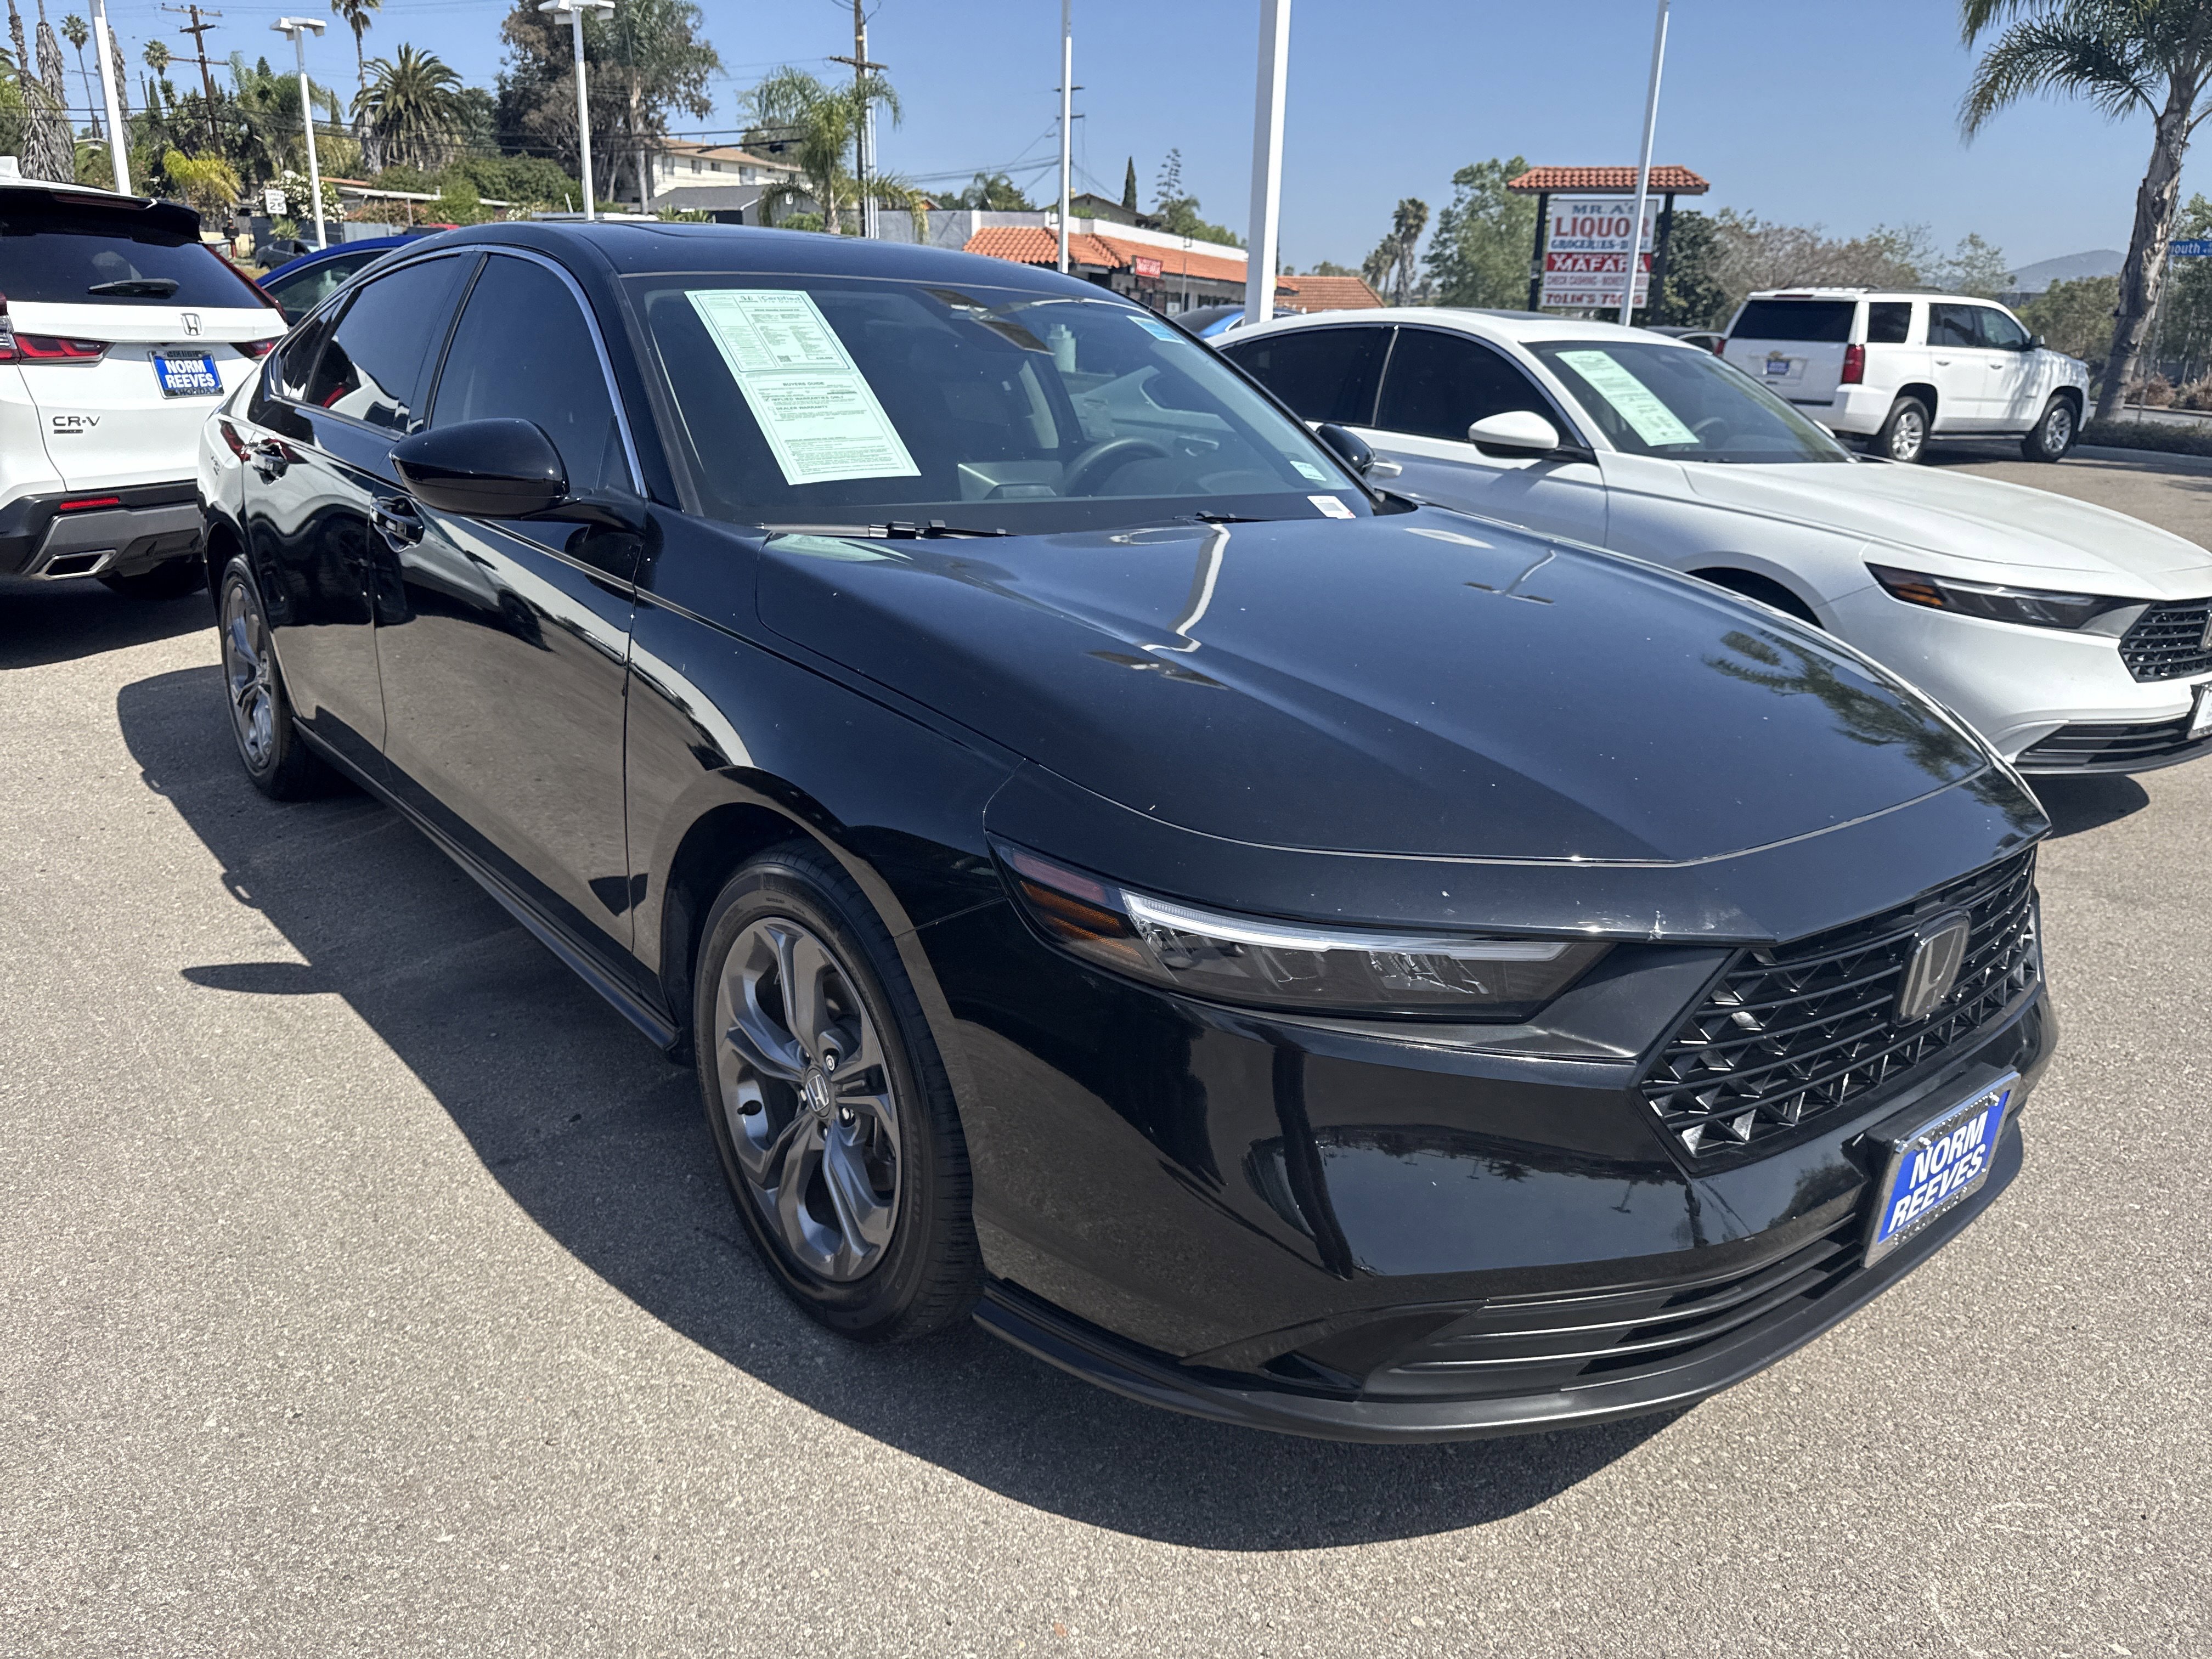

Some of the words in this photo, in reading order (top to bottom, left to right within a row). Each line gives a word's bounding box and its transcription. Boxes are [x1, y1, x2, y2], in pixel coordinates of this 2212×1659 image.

[269, 201, 284, 211] 25
[165, 359, 207, 374] NORM
[165, 373, 216, 388] REEVES
[1909, 1110, 1989, 1189] NORM
[1887, 1144, 1986, 1233] REEVES
